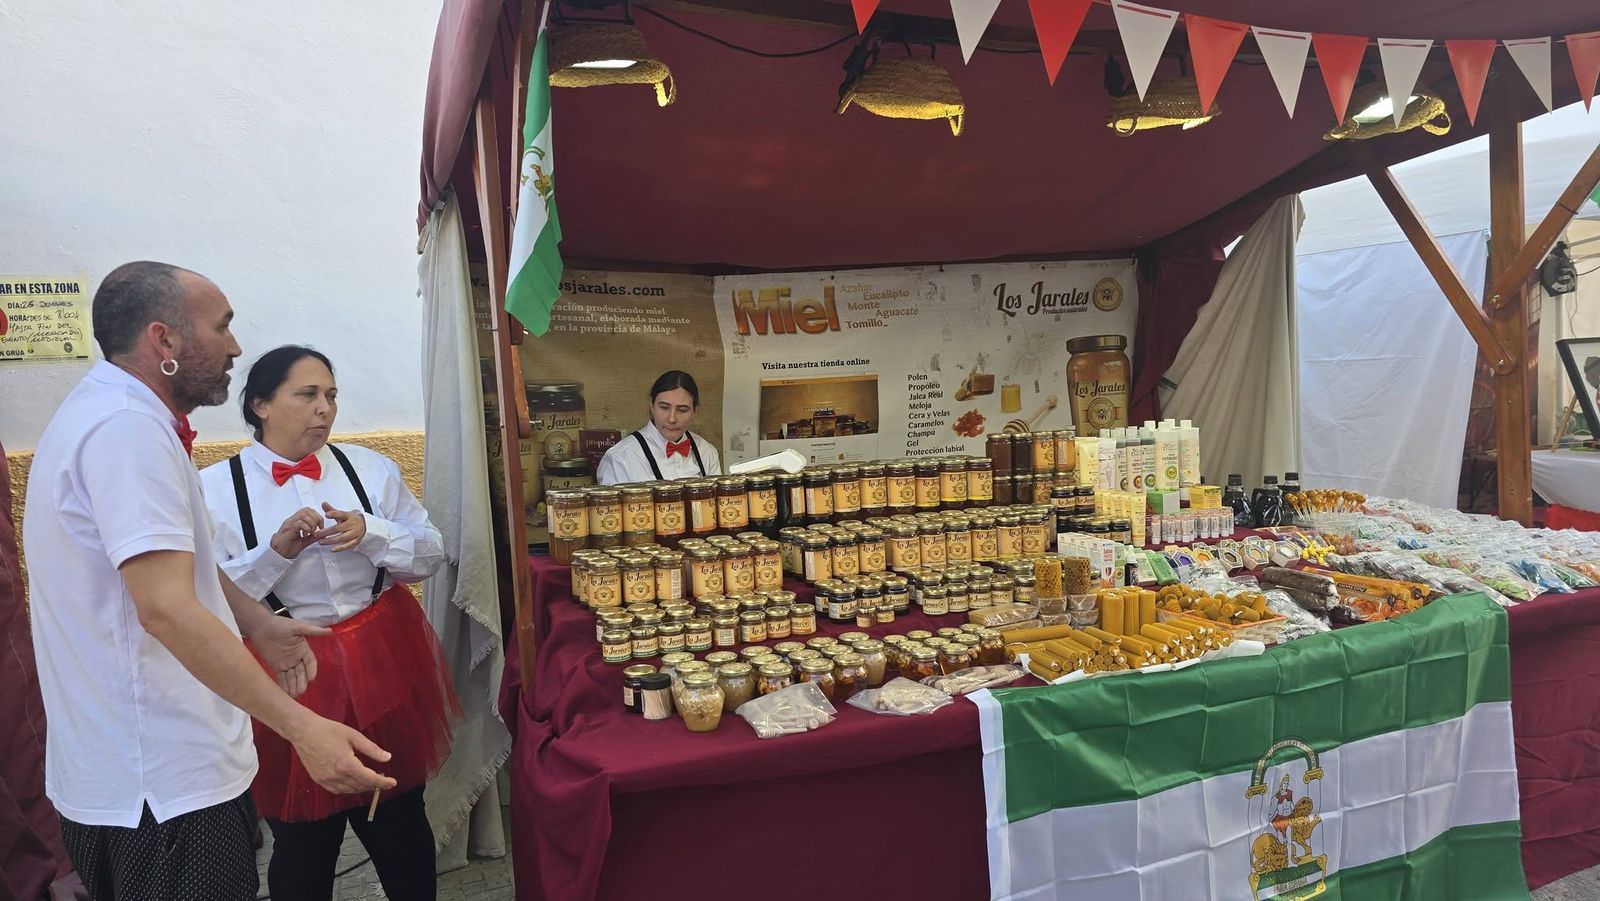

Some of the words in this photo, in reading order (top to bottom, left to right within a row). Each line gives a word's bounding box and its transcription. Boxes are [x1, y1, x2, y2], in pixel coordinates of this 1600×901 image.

[15, 284, 26, 294] EN
[30, 283, 53, 294] ESTA
[54, 283, 80, 293] ZONA
[840, 283, 873, 293] Azahar
[863, 289, 909, 301] Eucalipto
[993, 283, 1022, 318] Los
[1027, 281, 1090, 315] Jarales
[552, 302, 584, 311] ración
[586, 304, 643, 315] produciendo
[645, 307, 666, 315] miel
[732, 282, 841, 336] Miel
[847, 301, 880, 311] Monte
[551, 314, 597, 323] rtesanal,
[600, 314, 646, 323] elaborada
[648, 316, 691, 324] mediante
[569, 324, 578, 332] la
[580, 324, 627, 334] provincia
[629, 325, 641, 333] de
[762, 362, 786, 370] Visita
[788, 360, 819, 369] nuestra
[820, 359, 845, 367] tienda
[846, 358, 870, 366] online
[908, 382, 940, 391] Propóleo
[1072, 382, 1088, 398] Los
[1091, 380, 1126, 397] Jarales
[909, 402, 932, 410] Meloja
[547, 413, 580, 430] Jarales
[908, 420, 945, 429] Caramelos
[907, 429, 935, 438] Champú
[905, 446, 944, 456] Protección
